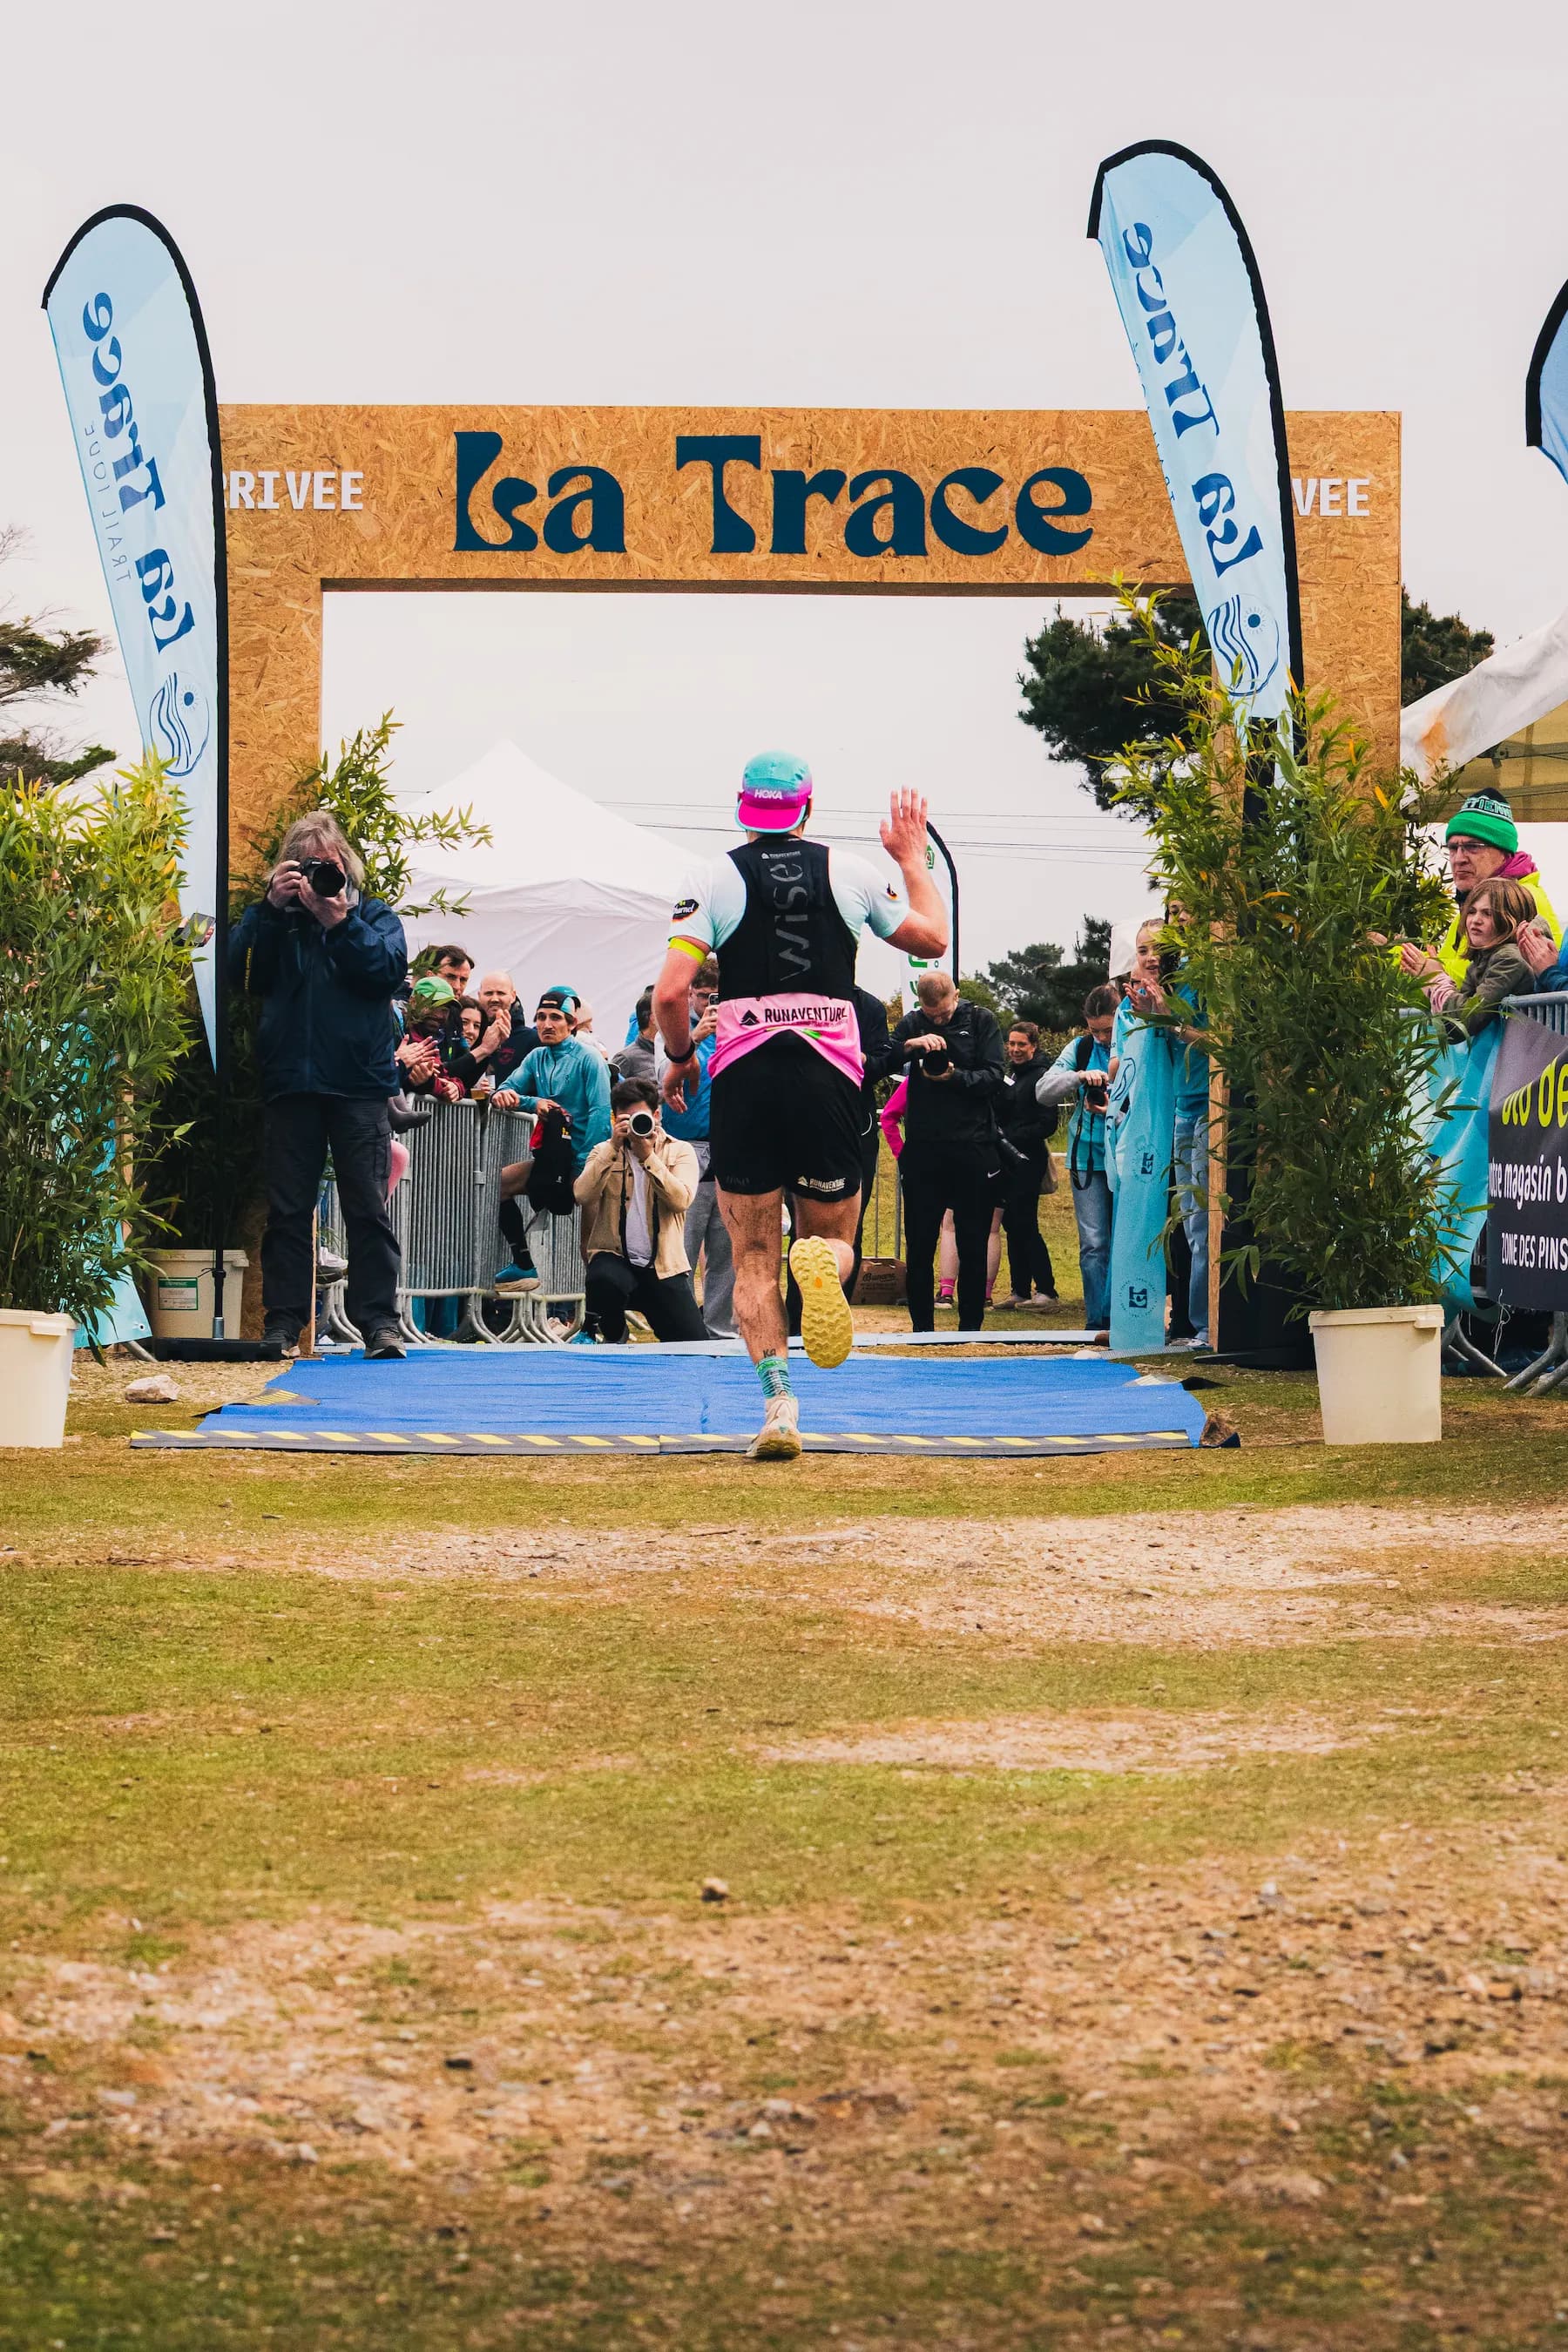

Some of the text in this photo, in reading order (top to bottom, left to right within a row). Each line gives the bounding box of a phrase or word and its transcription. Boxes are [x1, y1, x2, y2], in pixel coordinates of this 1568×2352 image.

[223, 470, 364, 510] RIVEE
[453, 431, 1093, 557] La Trace
[754, 788, 783, 800] HOKA
[764, 1006, 848, 1023] RUNAVENTURE
[1504, 1154, 1552, 1210] magasin
[1502, 1232, 1568, 1272] ZONE DES PINS
